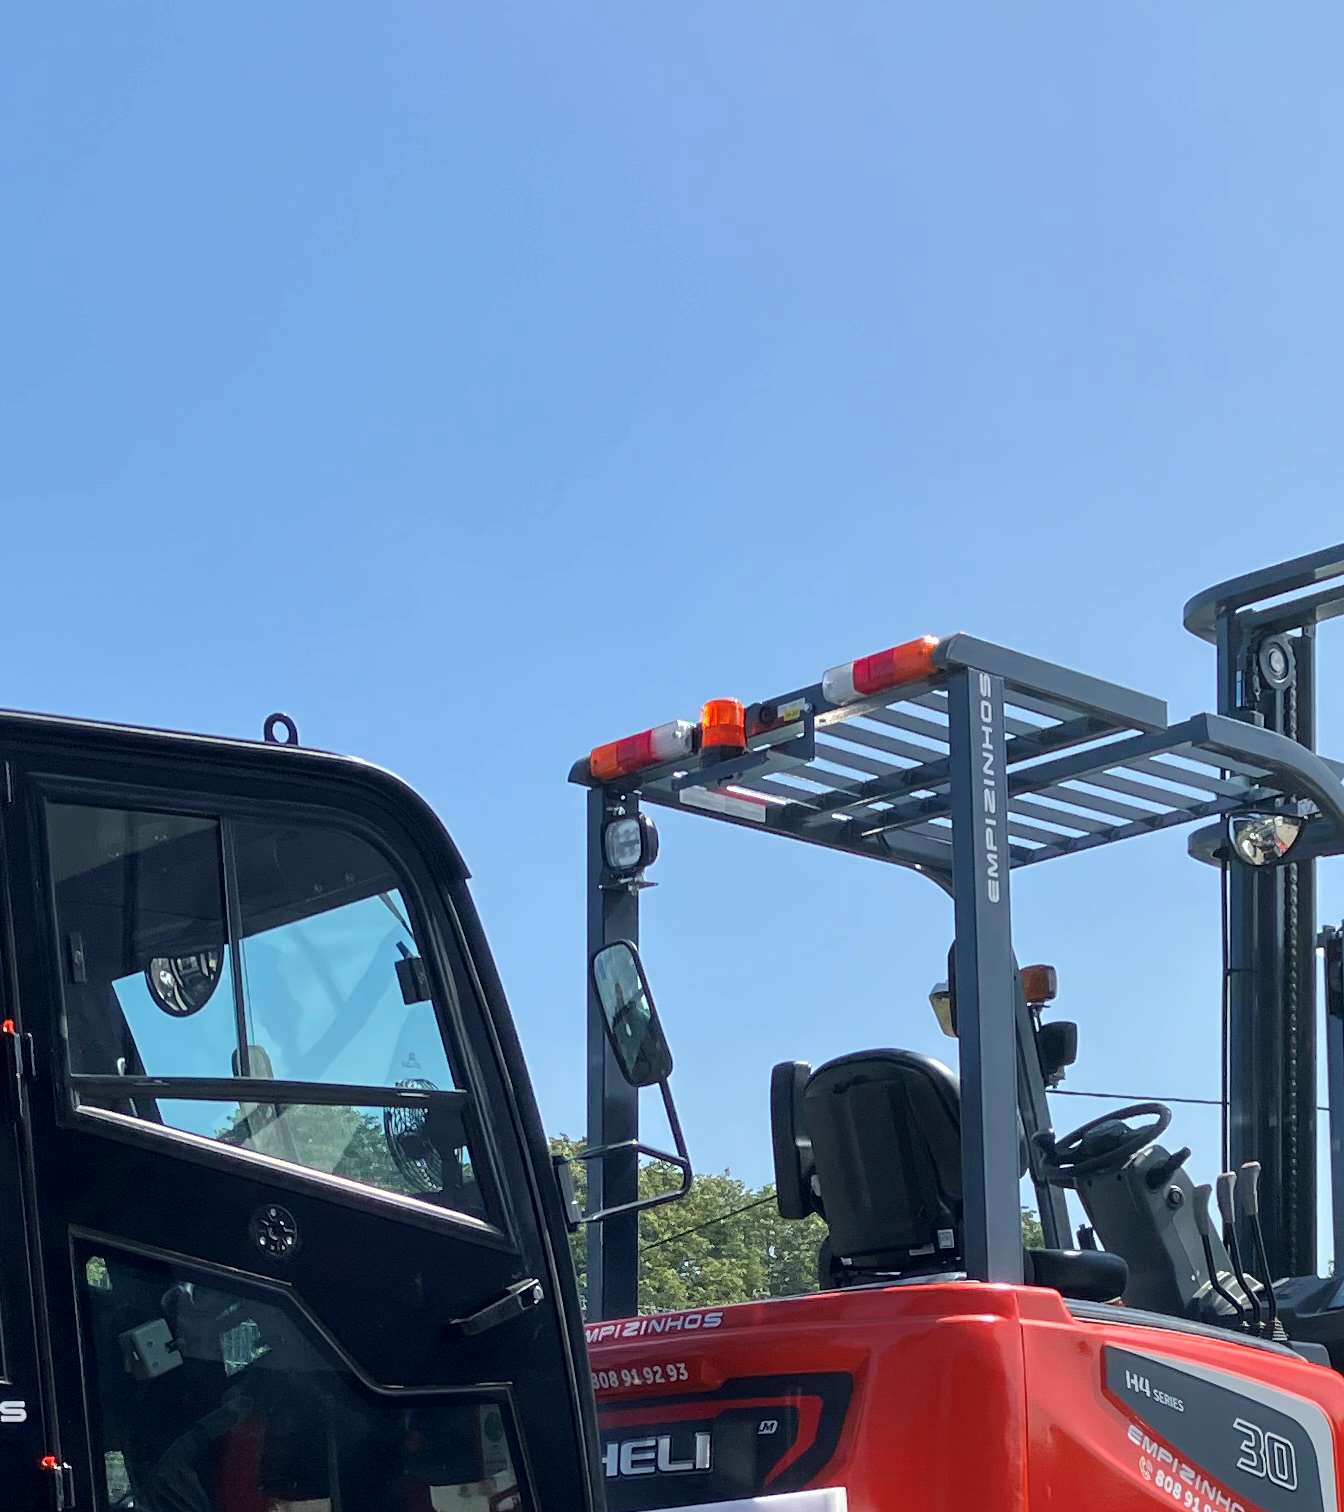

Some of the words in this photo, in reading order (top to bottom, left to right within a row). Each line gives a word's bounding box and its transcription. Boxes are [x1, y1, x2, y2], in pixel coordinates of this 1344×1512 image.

[979, 672, 1000, 903] EMPIZINHOS
[584, 1312, 723, 1344] MPIZINHOS
[621, 1368, 641, 1387] 91
[645, 1365, 666, 1385] 92
[666, 1362, 689, 1382] 93
[1125, 1370, 1151, 1398] H4
[1153, 1388, 1185, 1412] SERIES
[1233, 1417, 1298, 1491] 30
[1155, 1470, 1182, 1499] 808
